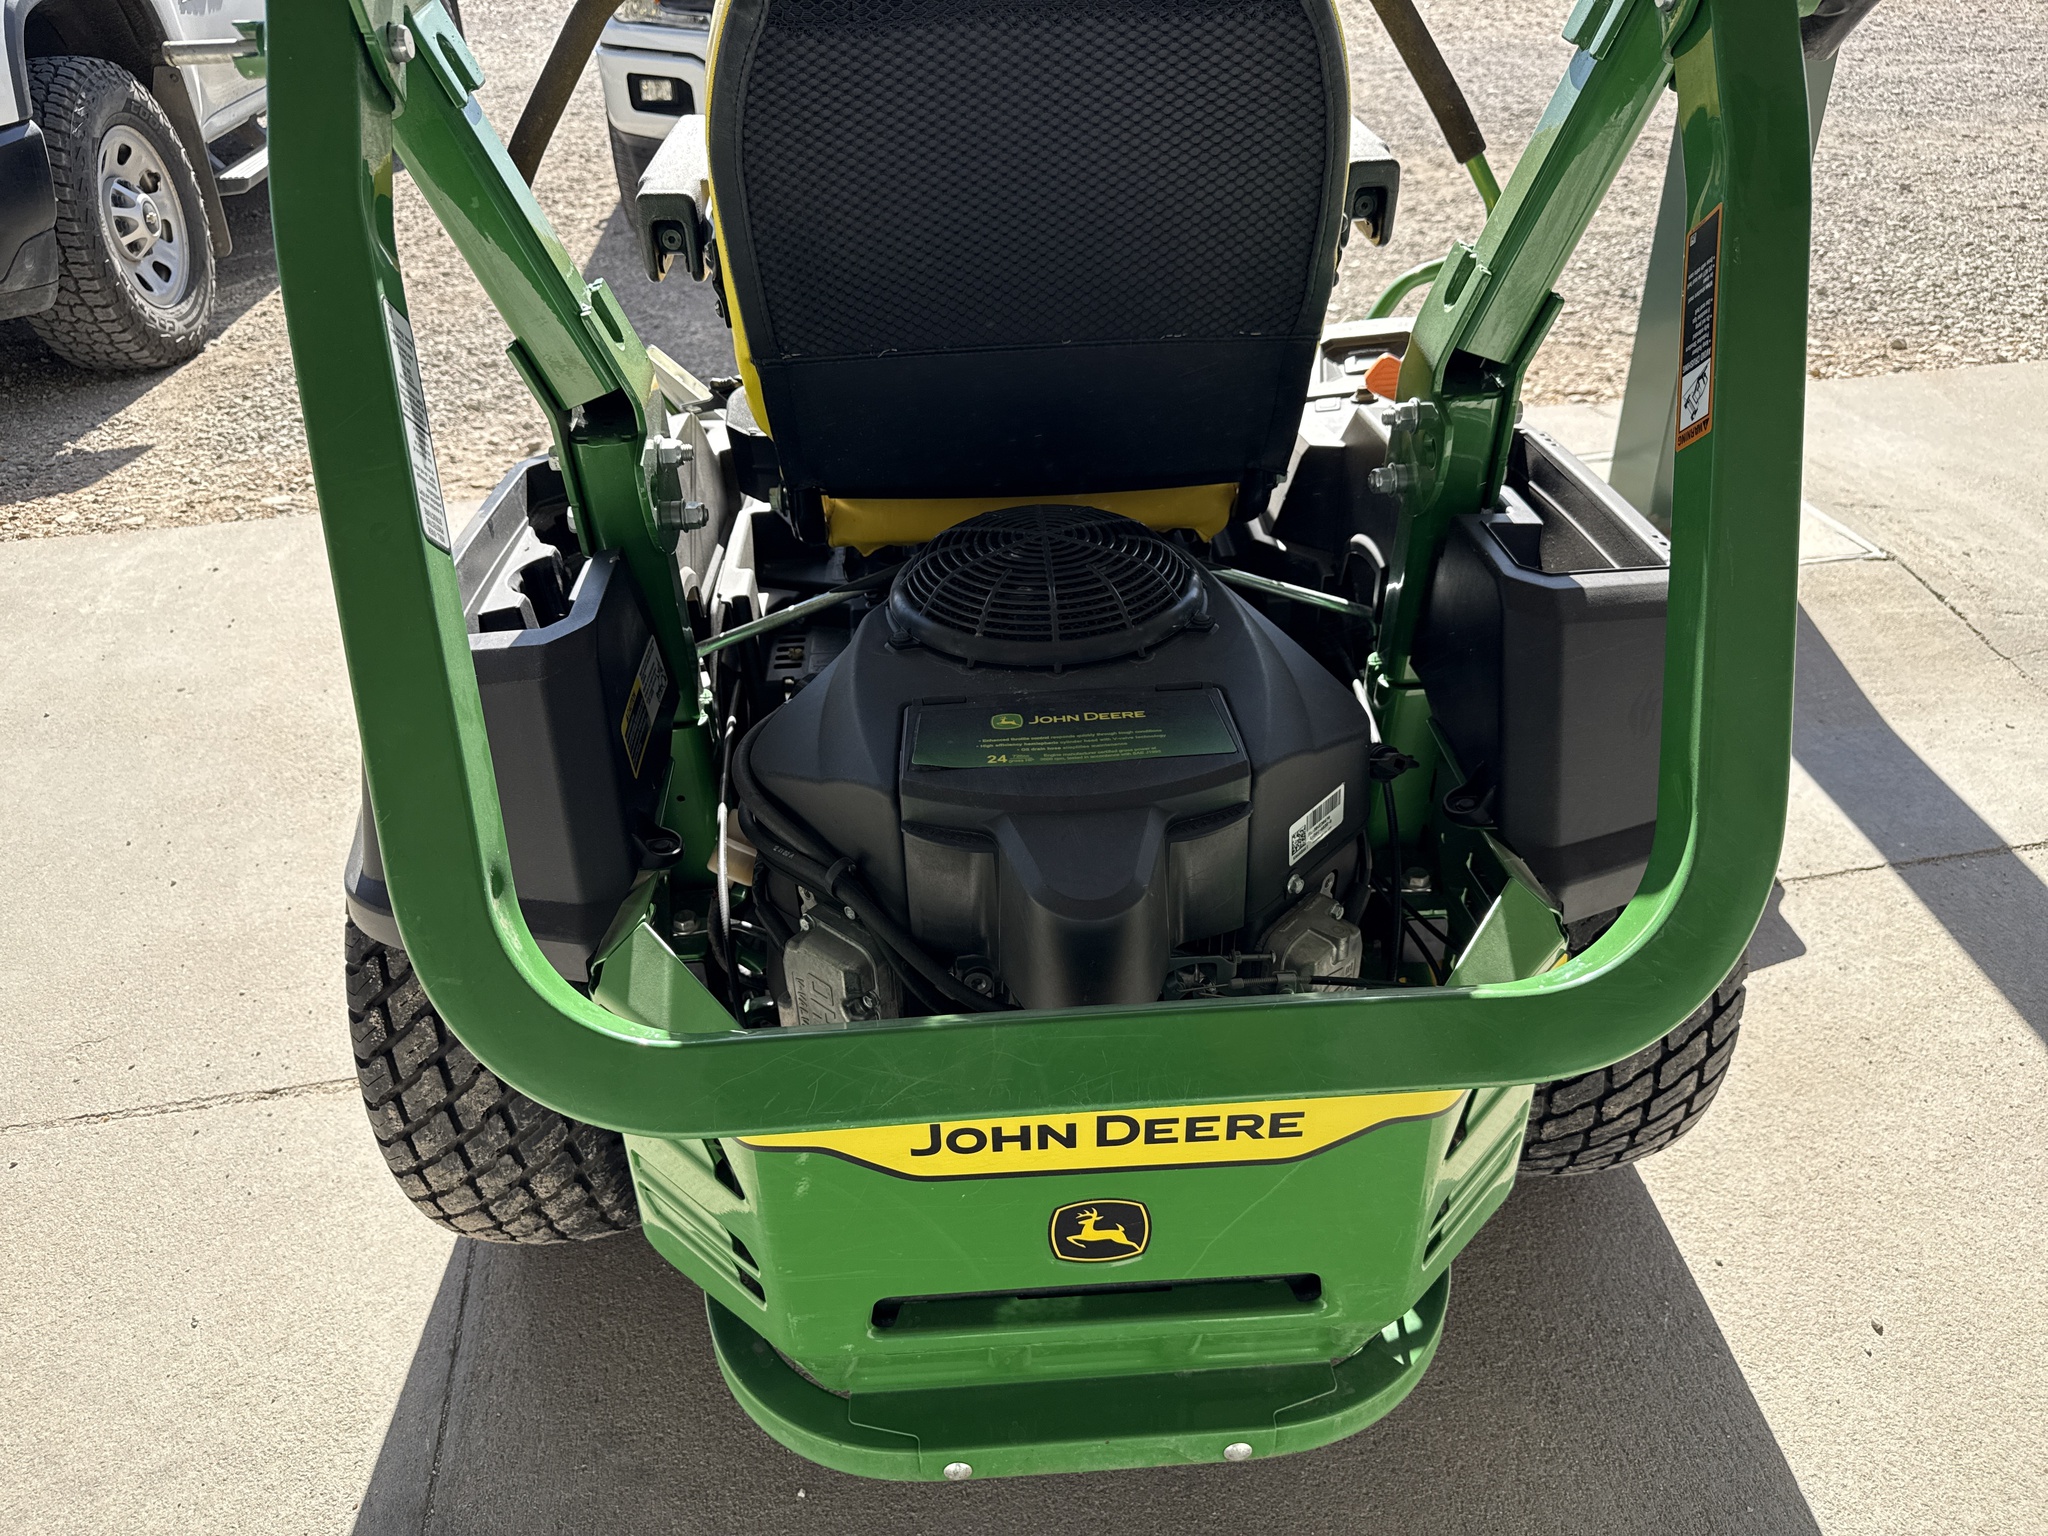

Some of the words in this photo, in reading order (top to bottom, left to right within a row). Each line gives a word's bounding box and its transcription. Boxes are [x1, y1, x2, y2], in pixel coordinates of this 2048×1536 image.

[1683, 354, 1700, 374] CRUSHING
[1678, 425, 1702, 446] WARNING
[1029, 714, 1080, 725] JOHN
[1083, 710, 1146, 721] DEERE
[986, 754, 1008, 764] 24
[795, 977, 810, 1026] V-VALV
[910, 1122, 1077, 1157] JOHN
[1096, 1111, 1306, 1147] DEERE
